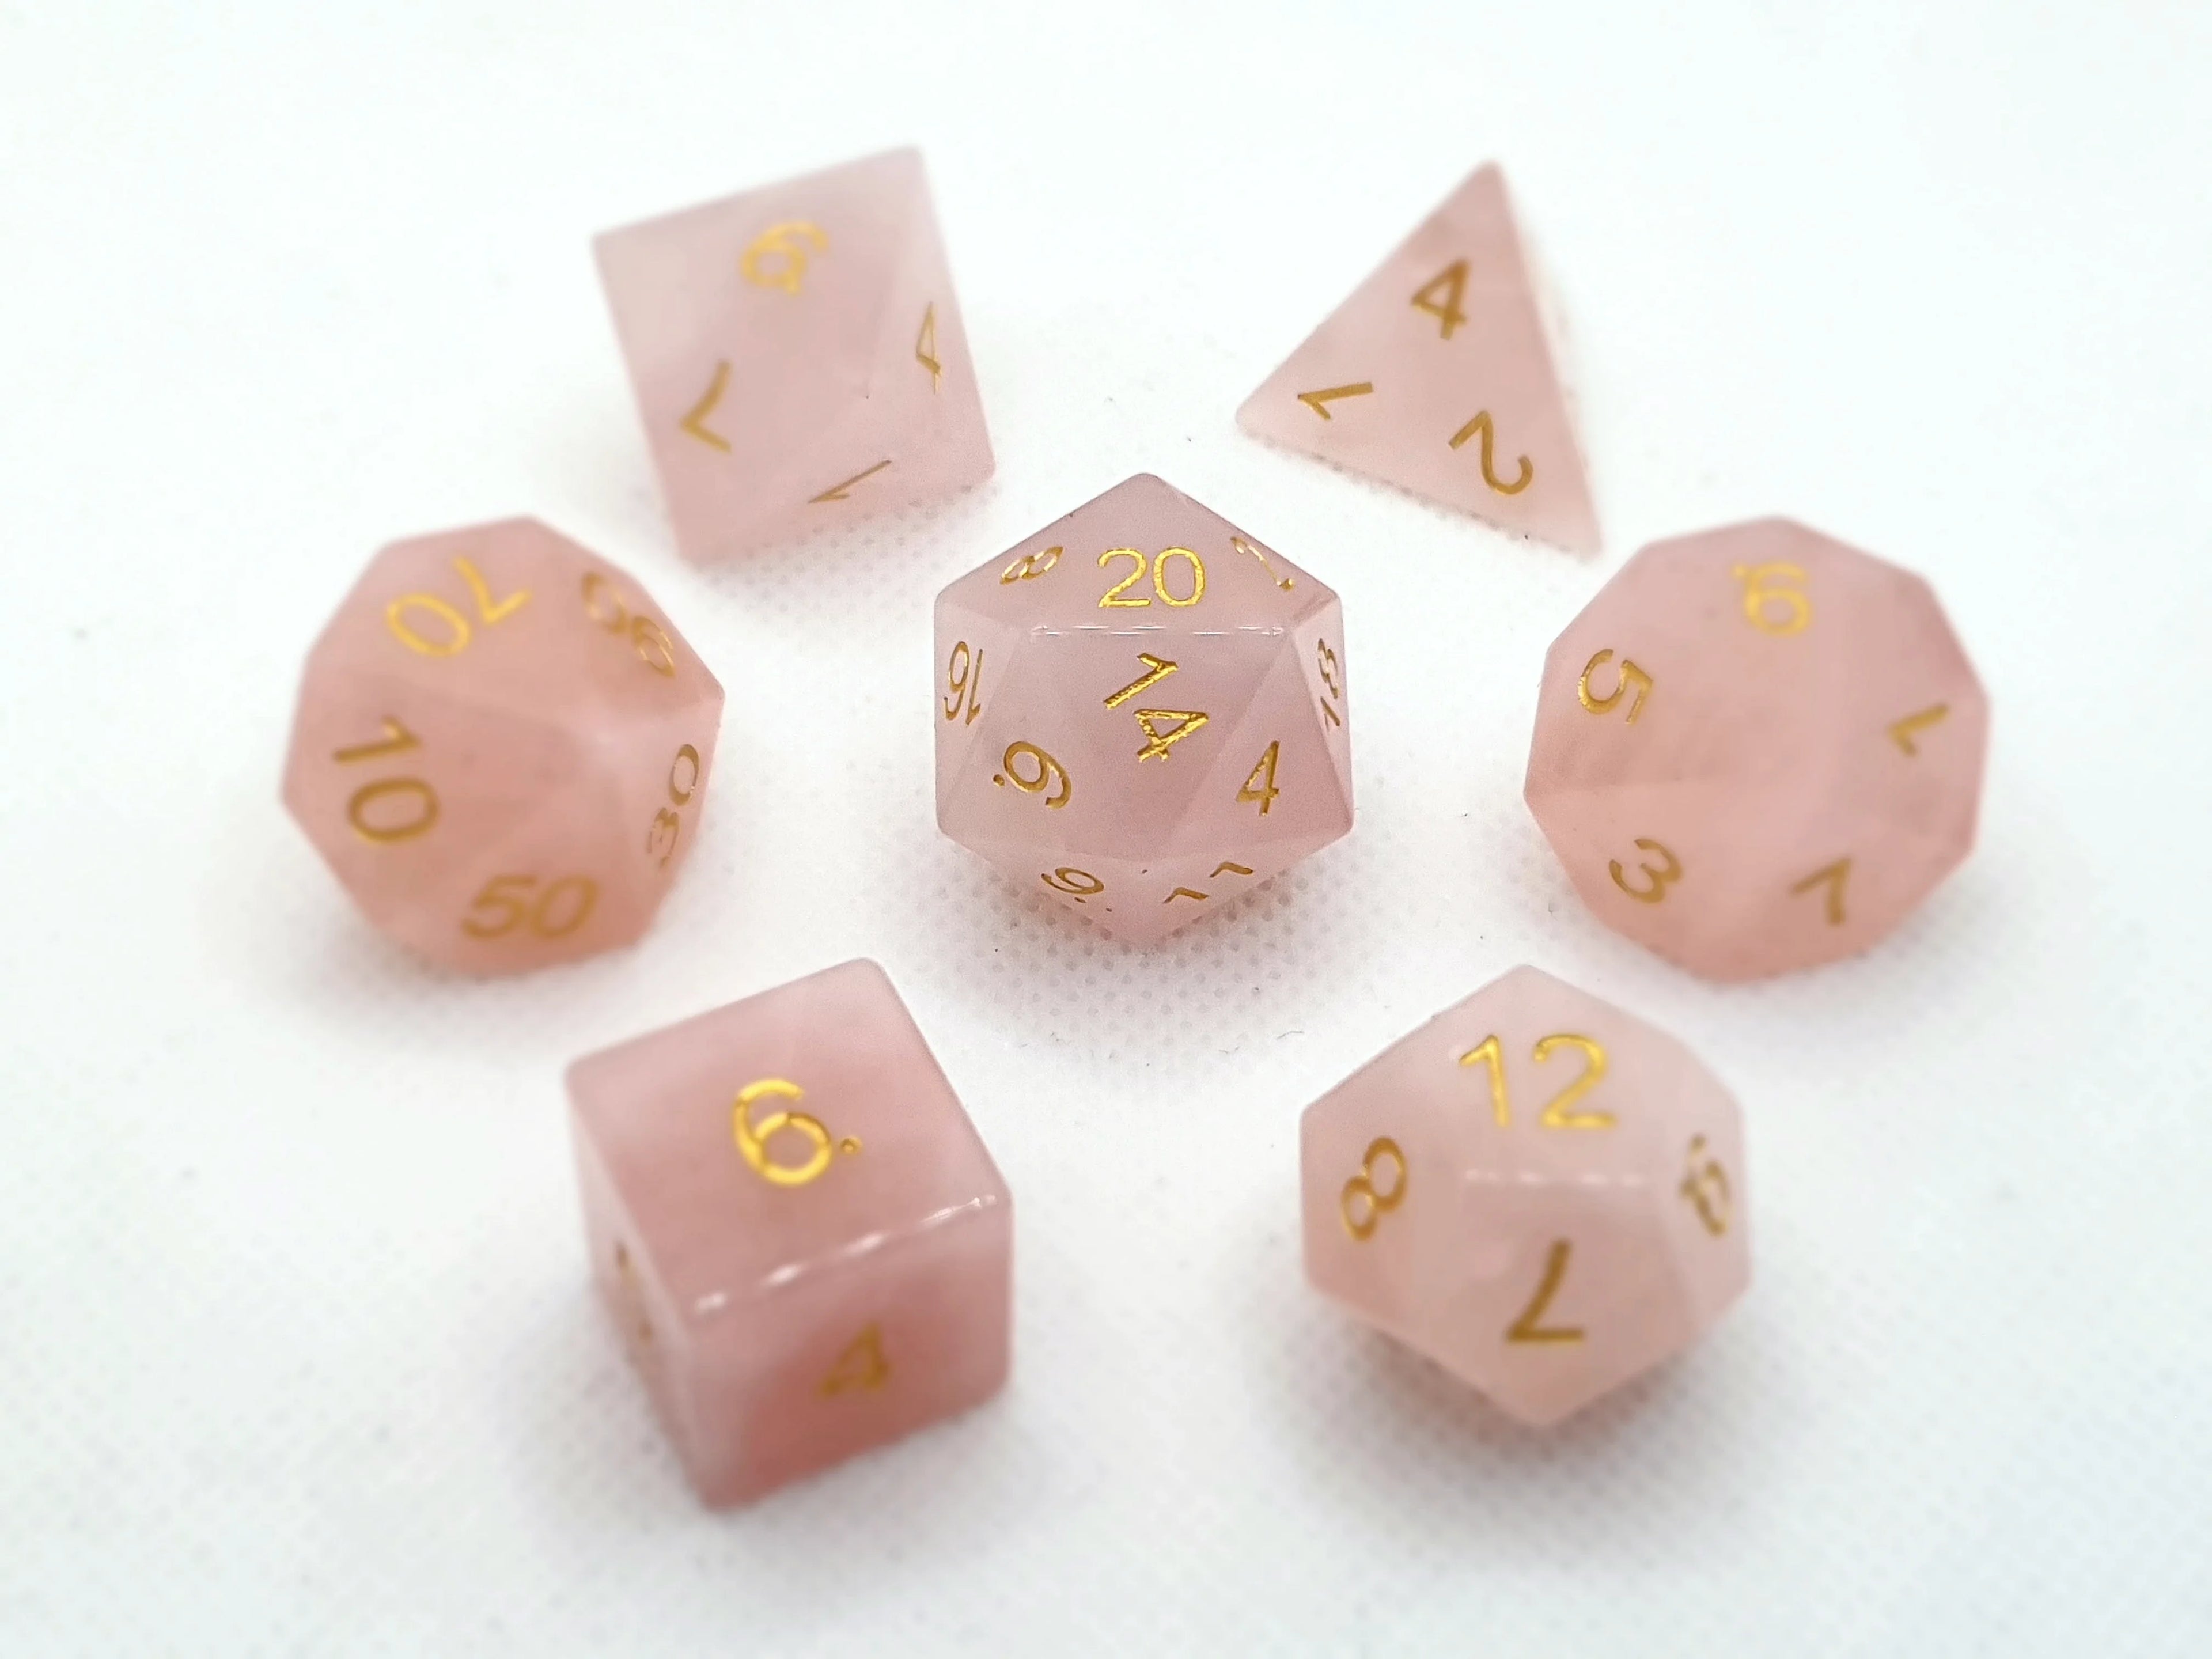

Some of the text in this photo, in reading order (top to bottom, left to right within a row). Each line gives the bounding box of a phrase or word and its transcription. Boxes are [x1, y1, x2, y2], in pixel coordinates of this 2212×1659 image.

[1412, 261, 1471, 340] 4
[1450, 411, 1534, 498] 2
[1001, 546, 1063, 585] 8
[1097, 547, 1207, 608] 20
[1105, 653, 1210, 762] 14
[1579, 649, 1654, 726] 5
[332, 717, 440, 846] 10
[1237, 741, 1280, 816] 4
[461, 873, 603, 945] 50
[1609, 838, 1684, 906] 3
[1459, 1033, 1617, 1130] 12
[1341, 1137, 1408, 1244] 8
[1506, 1241, 1585, 1348] 7
